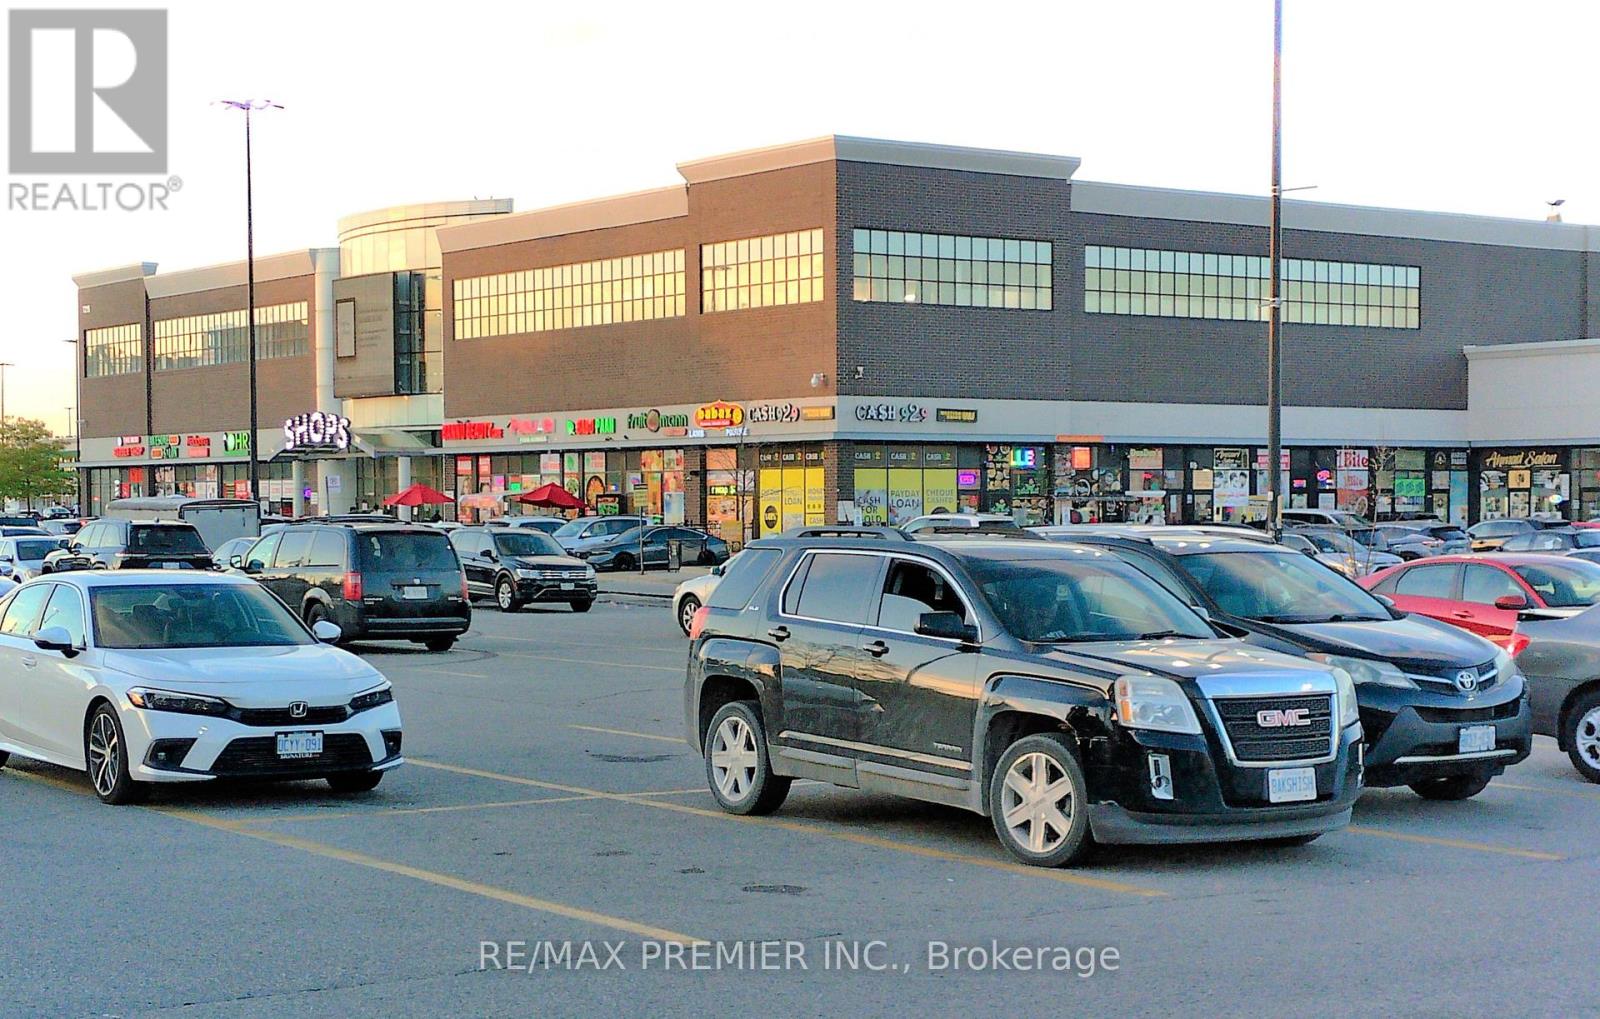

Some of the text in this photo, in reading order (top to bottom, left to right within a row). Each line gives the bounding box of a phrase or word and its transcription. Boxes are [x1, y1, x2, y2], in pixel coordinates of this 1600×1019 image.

[749, 405, 777, 422] CASH
[855, 404, 896, 421] CASH
[900, 403, 928, 422] 929
[284, 411, 351, 450] SHOPS
[1524, 450, 1558, 466] Salon
[890, 490, 920, 498] PAYDAY
[861, 505, 878, 514] FOR
[891, 498, 920, 509] LOAN
[1256, 708, 1312, 728] GMC
